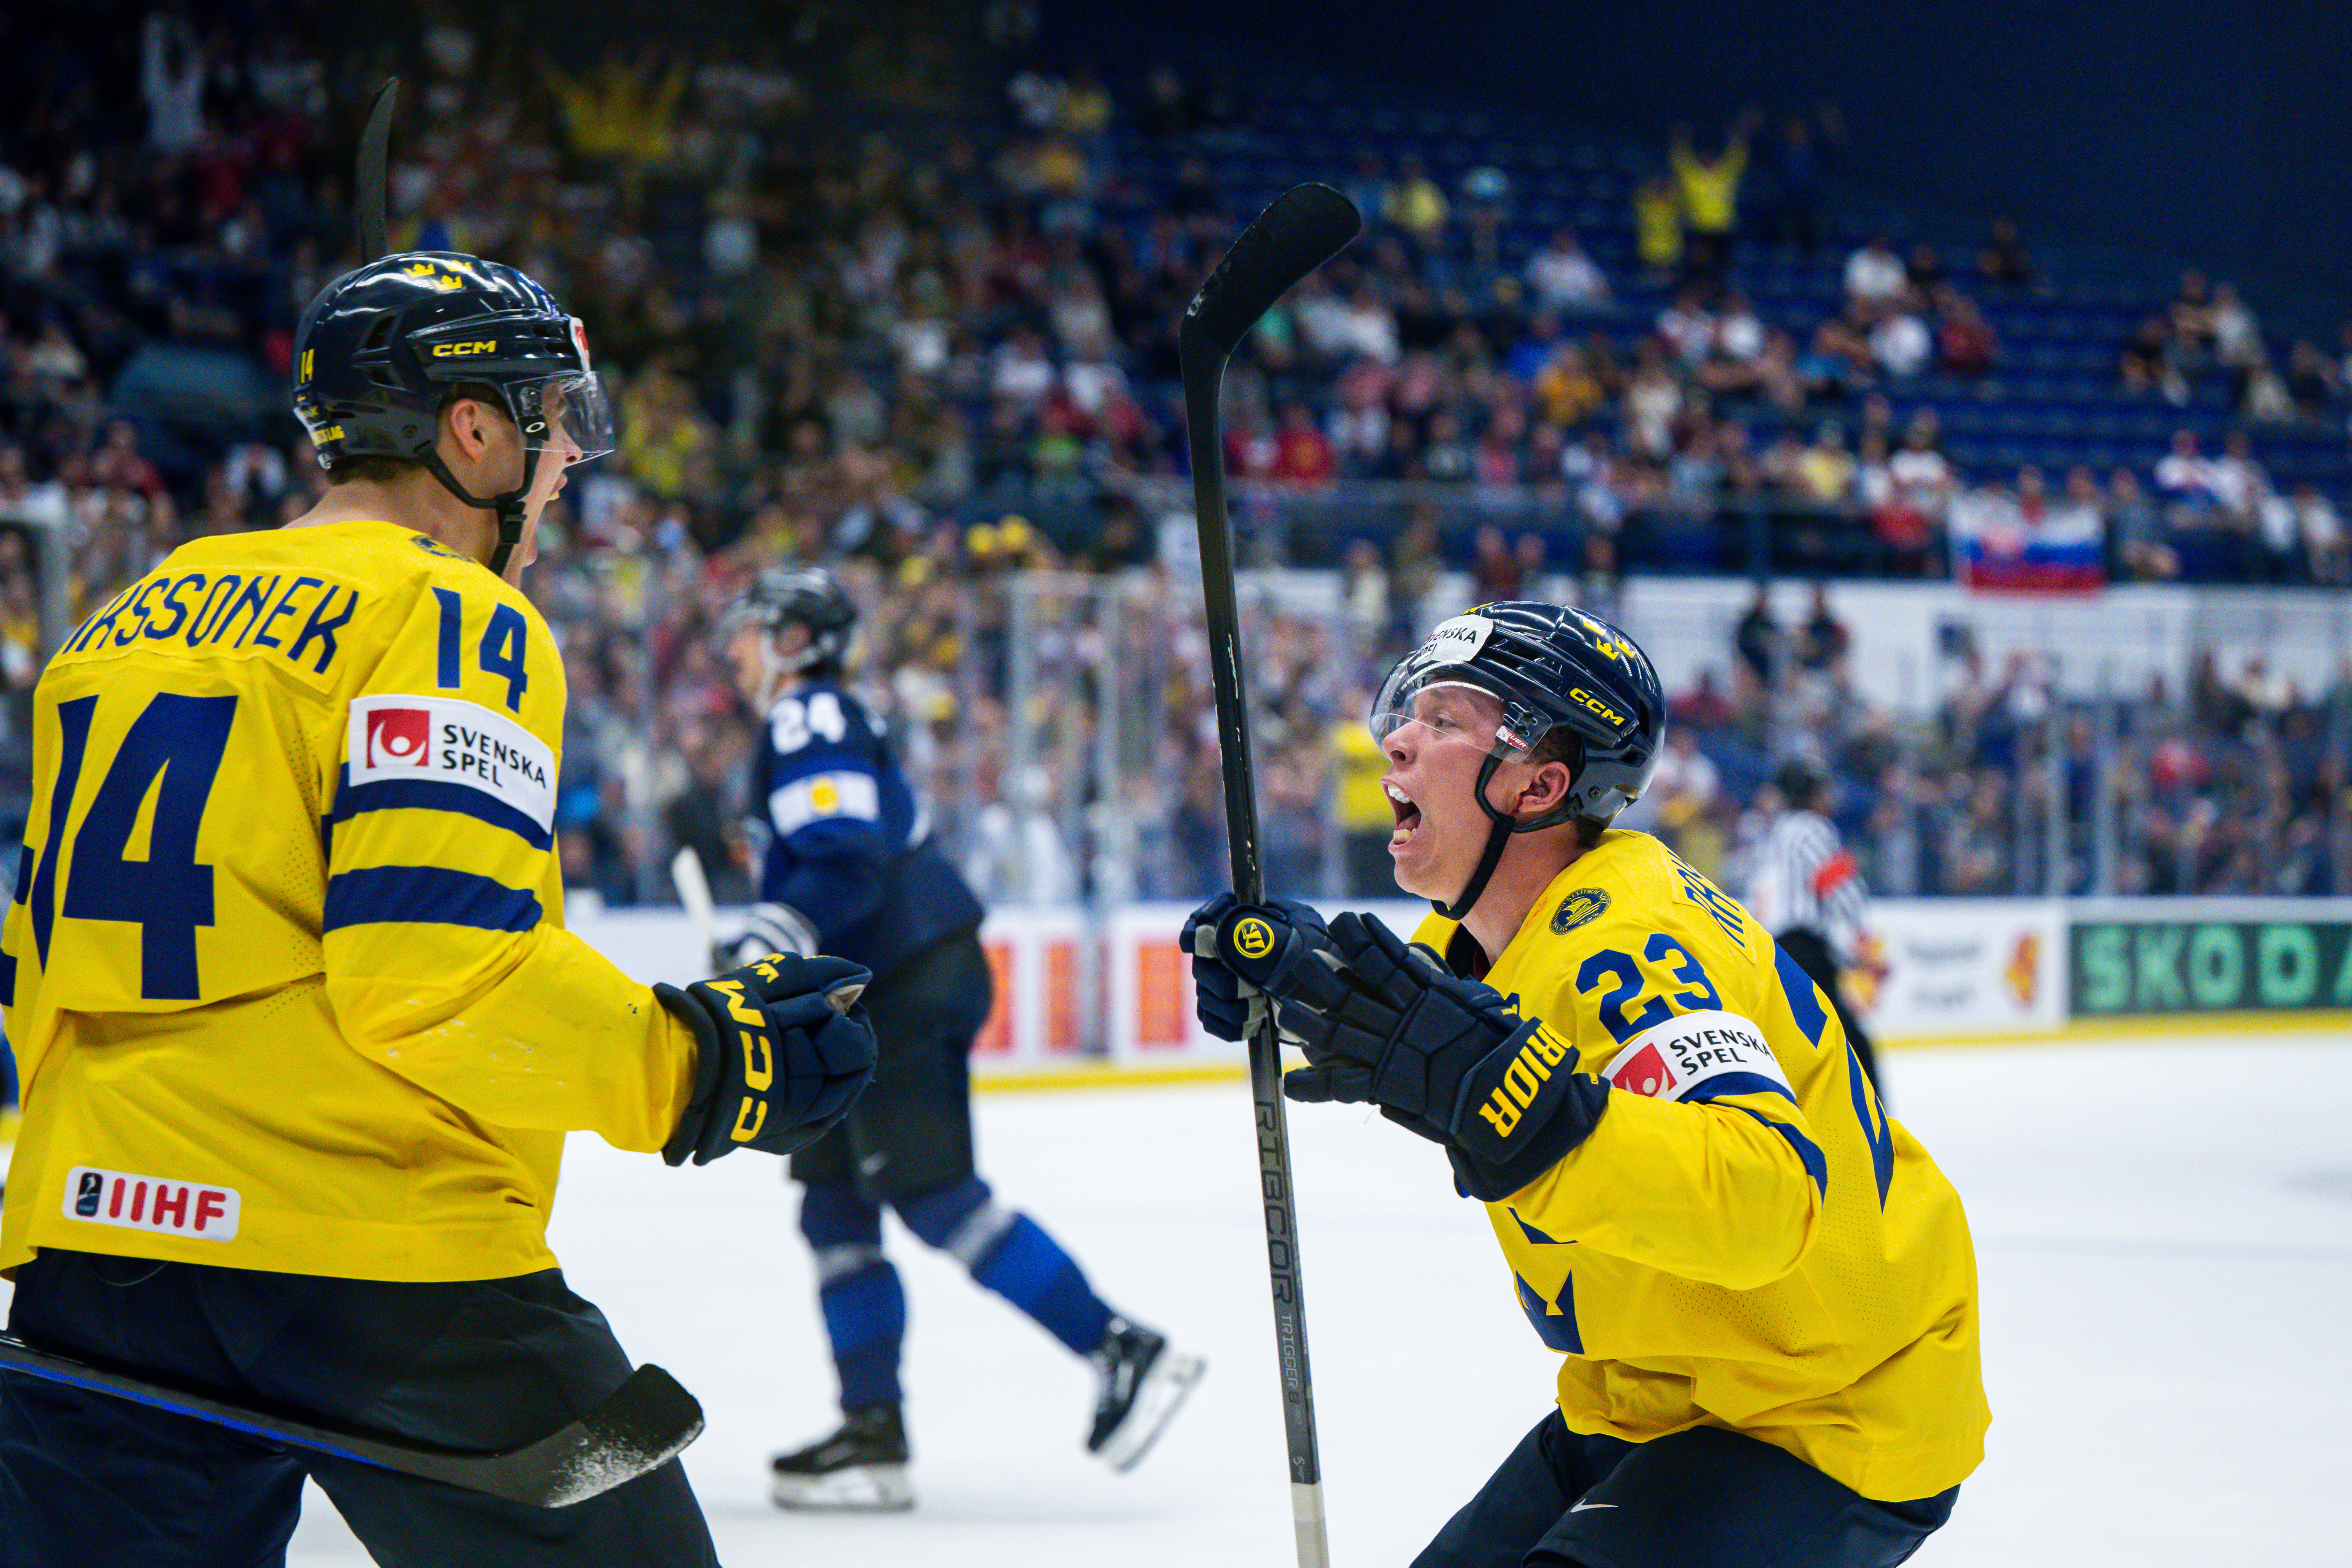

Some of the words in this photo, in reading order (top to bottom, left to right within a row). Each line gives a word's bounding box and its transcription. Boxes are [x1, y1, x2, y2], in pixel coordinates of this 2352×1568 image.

[433, 340, 497, 357] CCM
[431, 586, 528, 714] 14
[769, 692, 848, 755] 24
[1570, 688, 1625, 726] CCM
[442, 749, 503, 788] SPEL
[443, 724, 546, 790] SVENSKA
[31, 692, 239, 1000] 14
[1575, 932, 1724, 1045] 23
[704, 980, 773, 1143] CCM
[1670, 1029, 1775, 1062] SVENSKA
[1681, 1047, 1748, 1076] SPEL
[108, 1178, 227, 1231] IIHF
[1255, 1101, 1293, 1305] RIBCOR
[1281, 1313, 1299, 1389] TRIGGER
